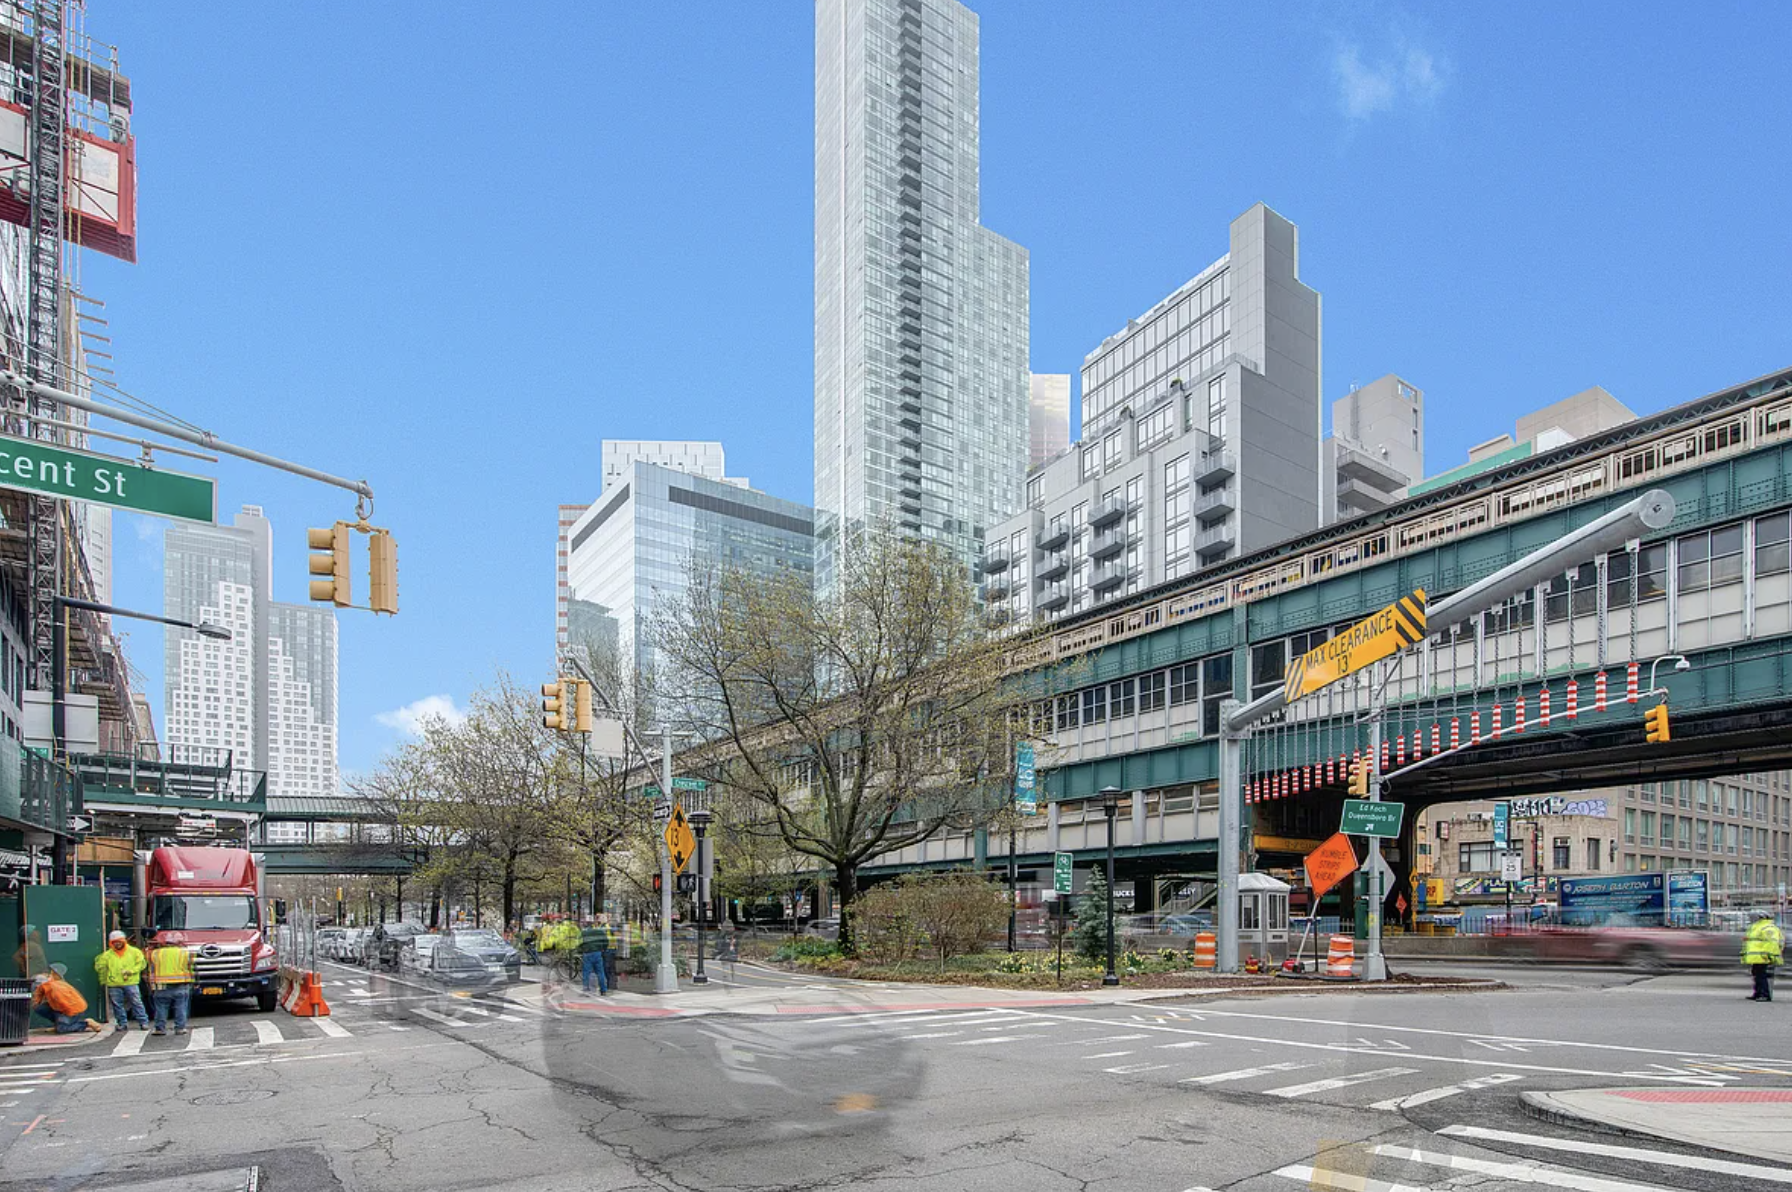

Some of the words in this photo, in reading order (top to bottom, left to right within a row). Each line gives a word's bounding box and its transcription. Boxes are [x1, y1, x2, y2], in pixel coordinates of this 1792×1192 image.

[93, 467, 127, 498] St
[1305, 646, 1327, 673] MAX
[1328, 608, 1393, 661] CLEARANCE
[1359, 803, 1369, 811] Ed
[1370, 804, 1388, 813] Koch
[1348, 811, 1387, 822] Queensboro
[1319, 848, 1348, 861] RUMBLE
[1318, 860, 1342, 871] STRIPS
[1506, 864, 1517, 872] 25
[1315, 871, 1336, 882] AHEAD
[50, 926, 71, 934] GATE
